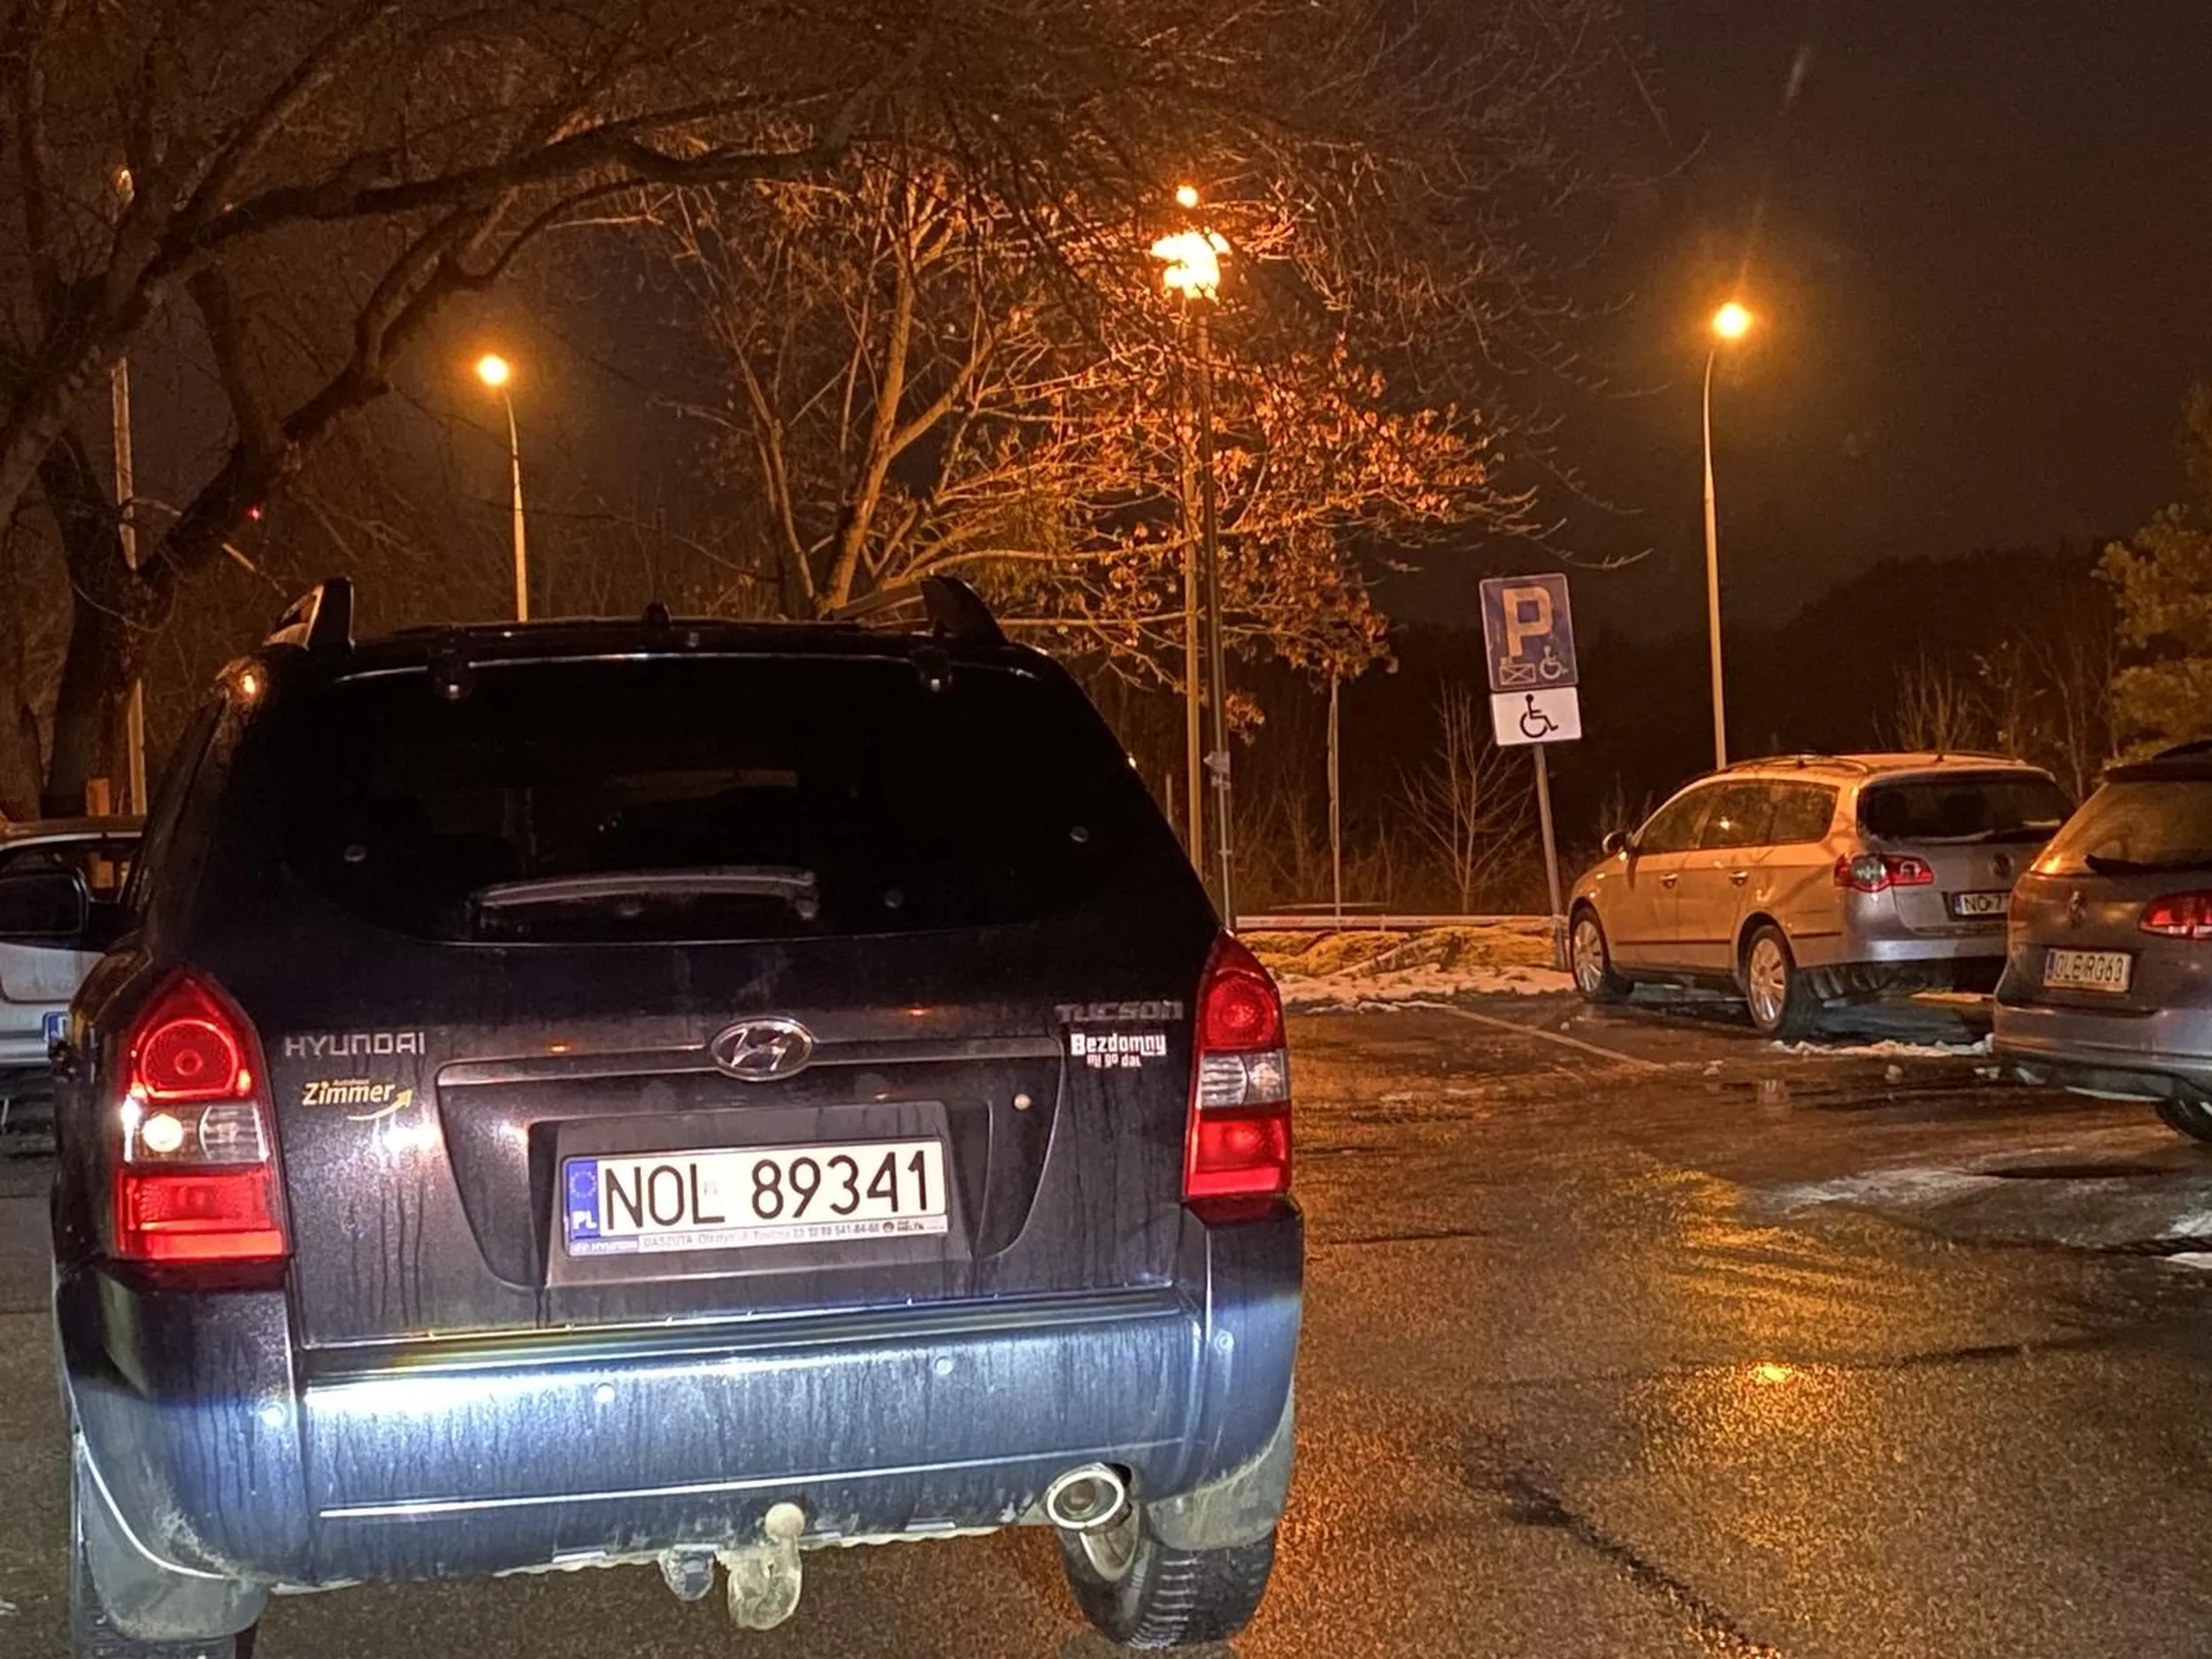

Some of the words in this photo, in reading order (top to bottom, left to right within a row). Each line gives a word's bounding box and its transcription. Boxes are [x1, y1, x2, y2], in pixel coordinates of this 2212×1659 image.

[1502, 587, 1553, 657] P
[1055, 1001, 1184, 1022] TUCSON
[285, 1032, 426, 1058] HYUNDAI
[1071, 1033, 1166, 1056] Bezdomny
[302, 1081, 396, 1106] Zimmer
[605, 1163, 725, 1230] NOL
[751, 1149, 927, 1219] 89341
[573, 1210, 598, 1230] PL
